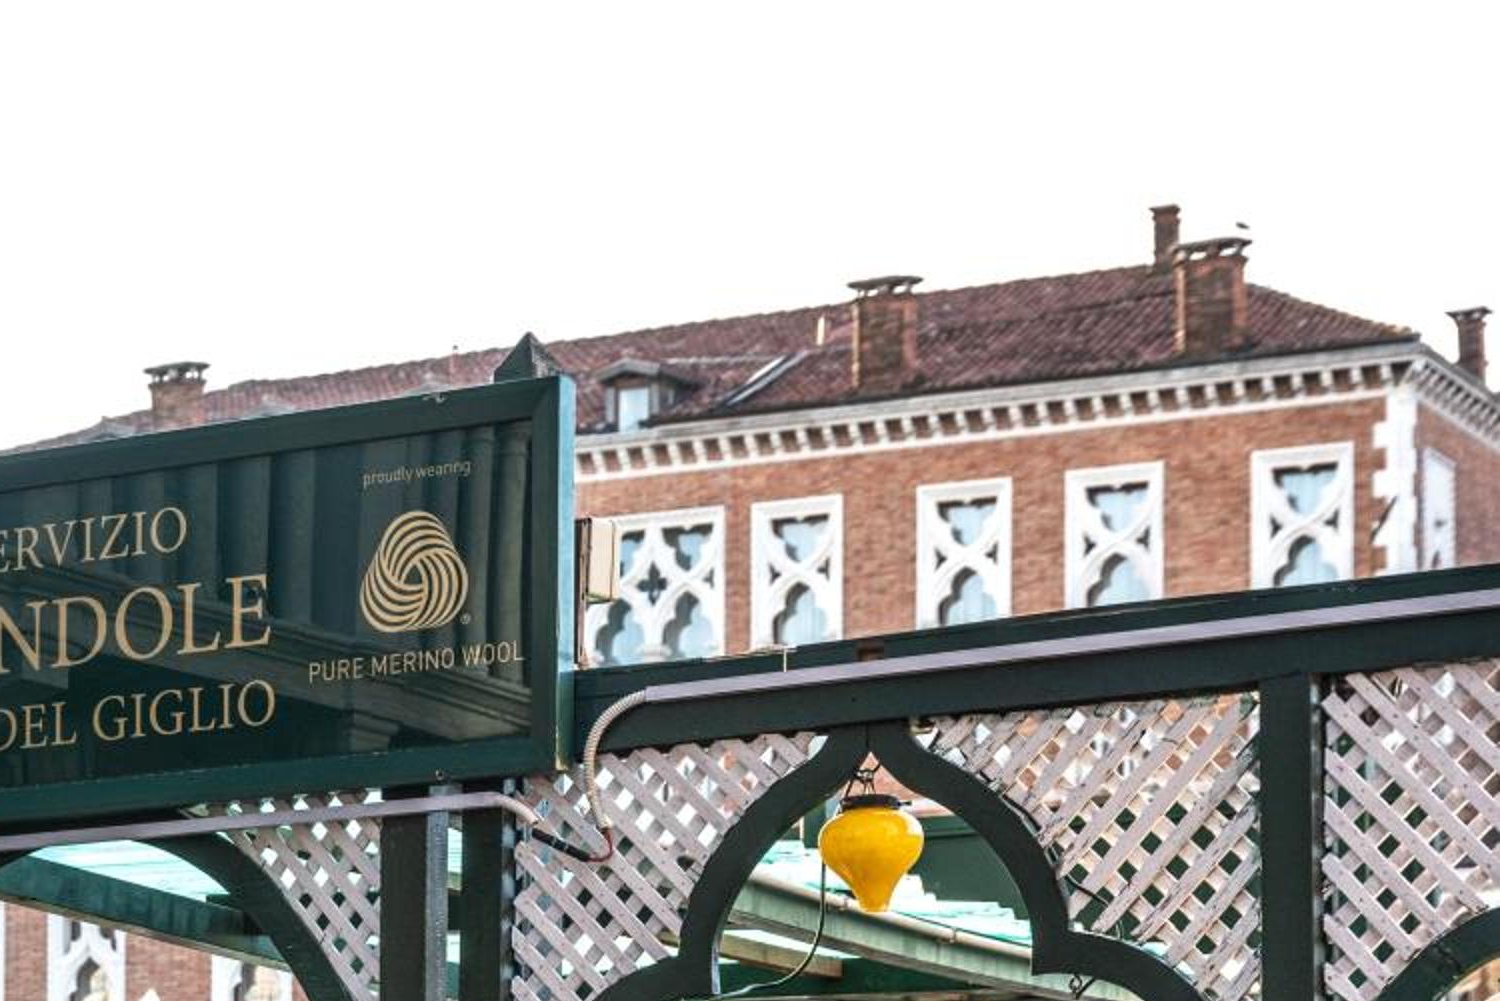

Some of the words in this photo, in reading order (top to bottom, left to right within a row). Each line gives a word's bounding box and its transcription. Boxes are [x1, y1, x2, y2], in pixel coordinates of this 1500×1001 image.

[363, 465, 415, 488] proudly
[416, 460, 471, 478] wearing
[308, 657, 364, 684] PURE
[371, 647, 455, 676] MERINO
[462, 640, 525, 667] WOOL
[92, 679, 277, 741] GIGLIO
